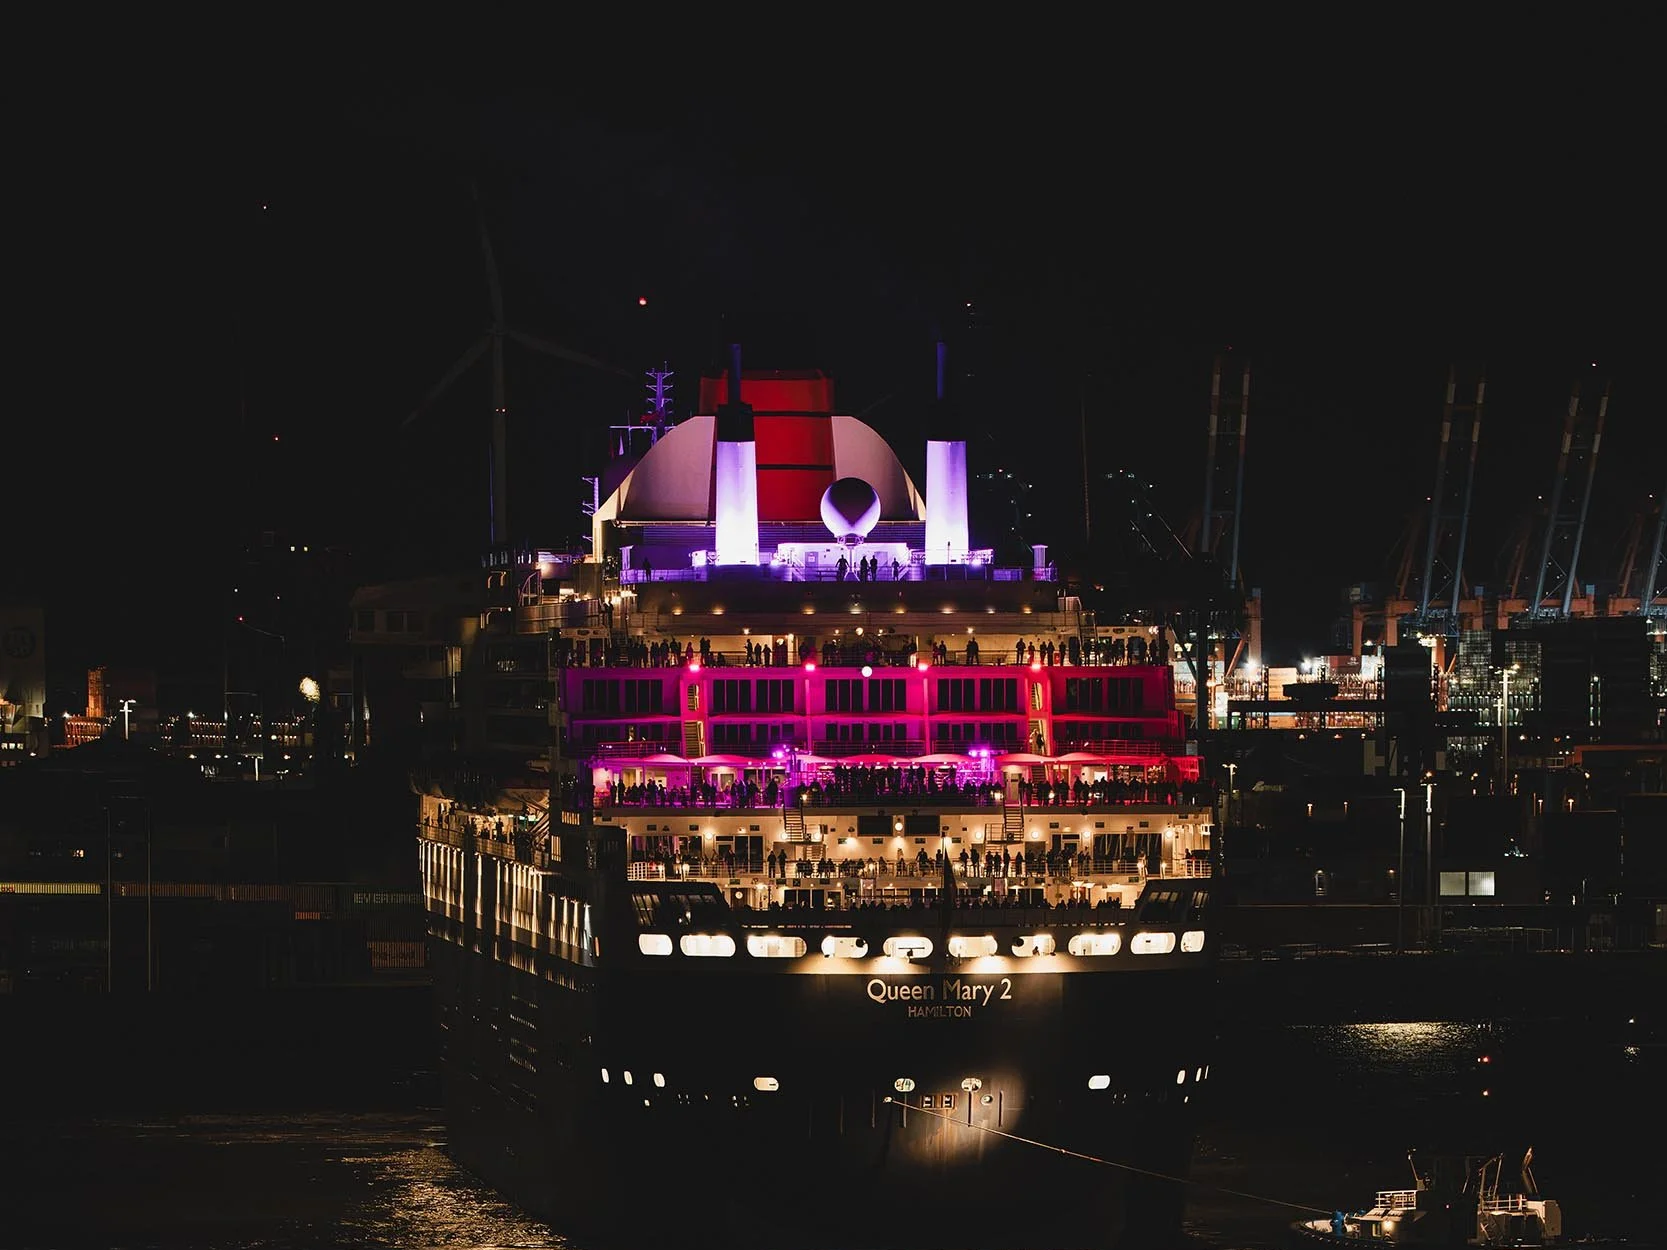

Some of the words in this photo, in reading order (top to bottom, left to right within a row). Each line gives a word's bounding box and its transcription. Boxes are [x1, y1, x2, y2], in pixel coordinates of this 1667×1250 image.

[866, 978, 935, 1004] Queen
[942, 978, 995, 1006] Mary
[999, 977, 1012, 1000] 2
[907, 1005, 972, 1018] HAMILTON
